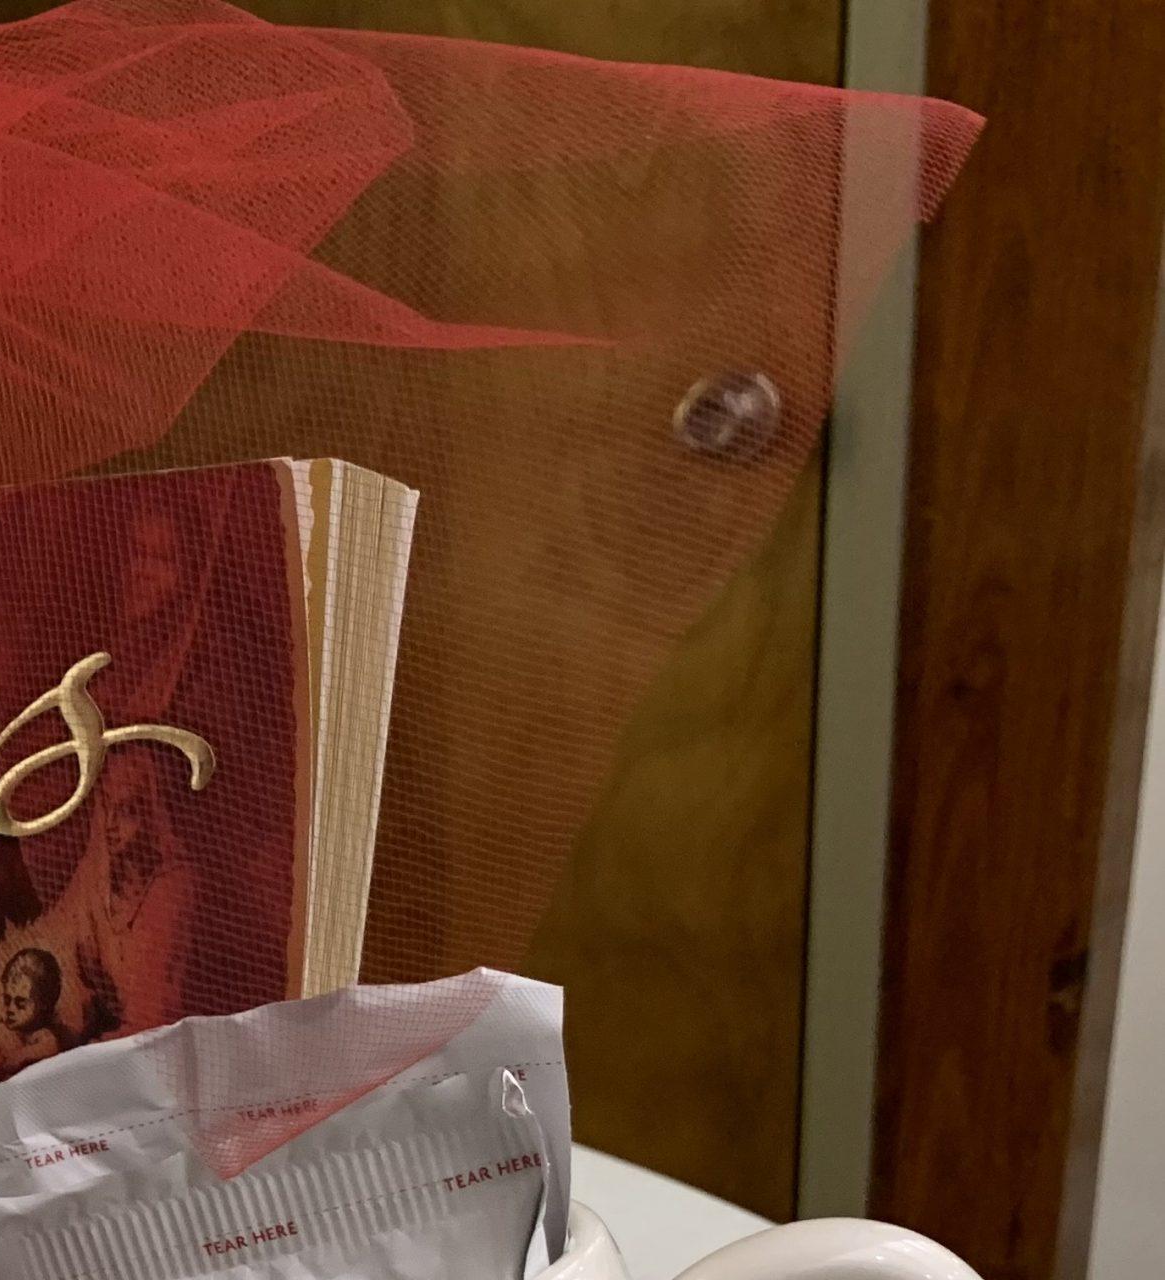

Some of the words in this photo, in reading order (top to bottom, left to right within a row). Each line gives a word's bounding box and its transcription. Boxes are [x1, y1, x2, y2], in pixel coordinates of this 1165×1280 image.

[25, 1150, 65, 1169] TEAR
[69, 1140, 110, 1157] HERE
[443, 1167, 492, 1191] TEAR
[497, 1153, 542, 1176] HERE
[202, 1236, 248, 1256] TEAR
[252, 1221, 298, 1244] HERE
